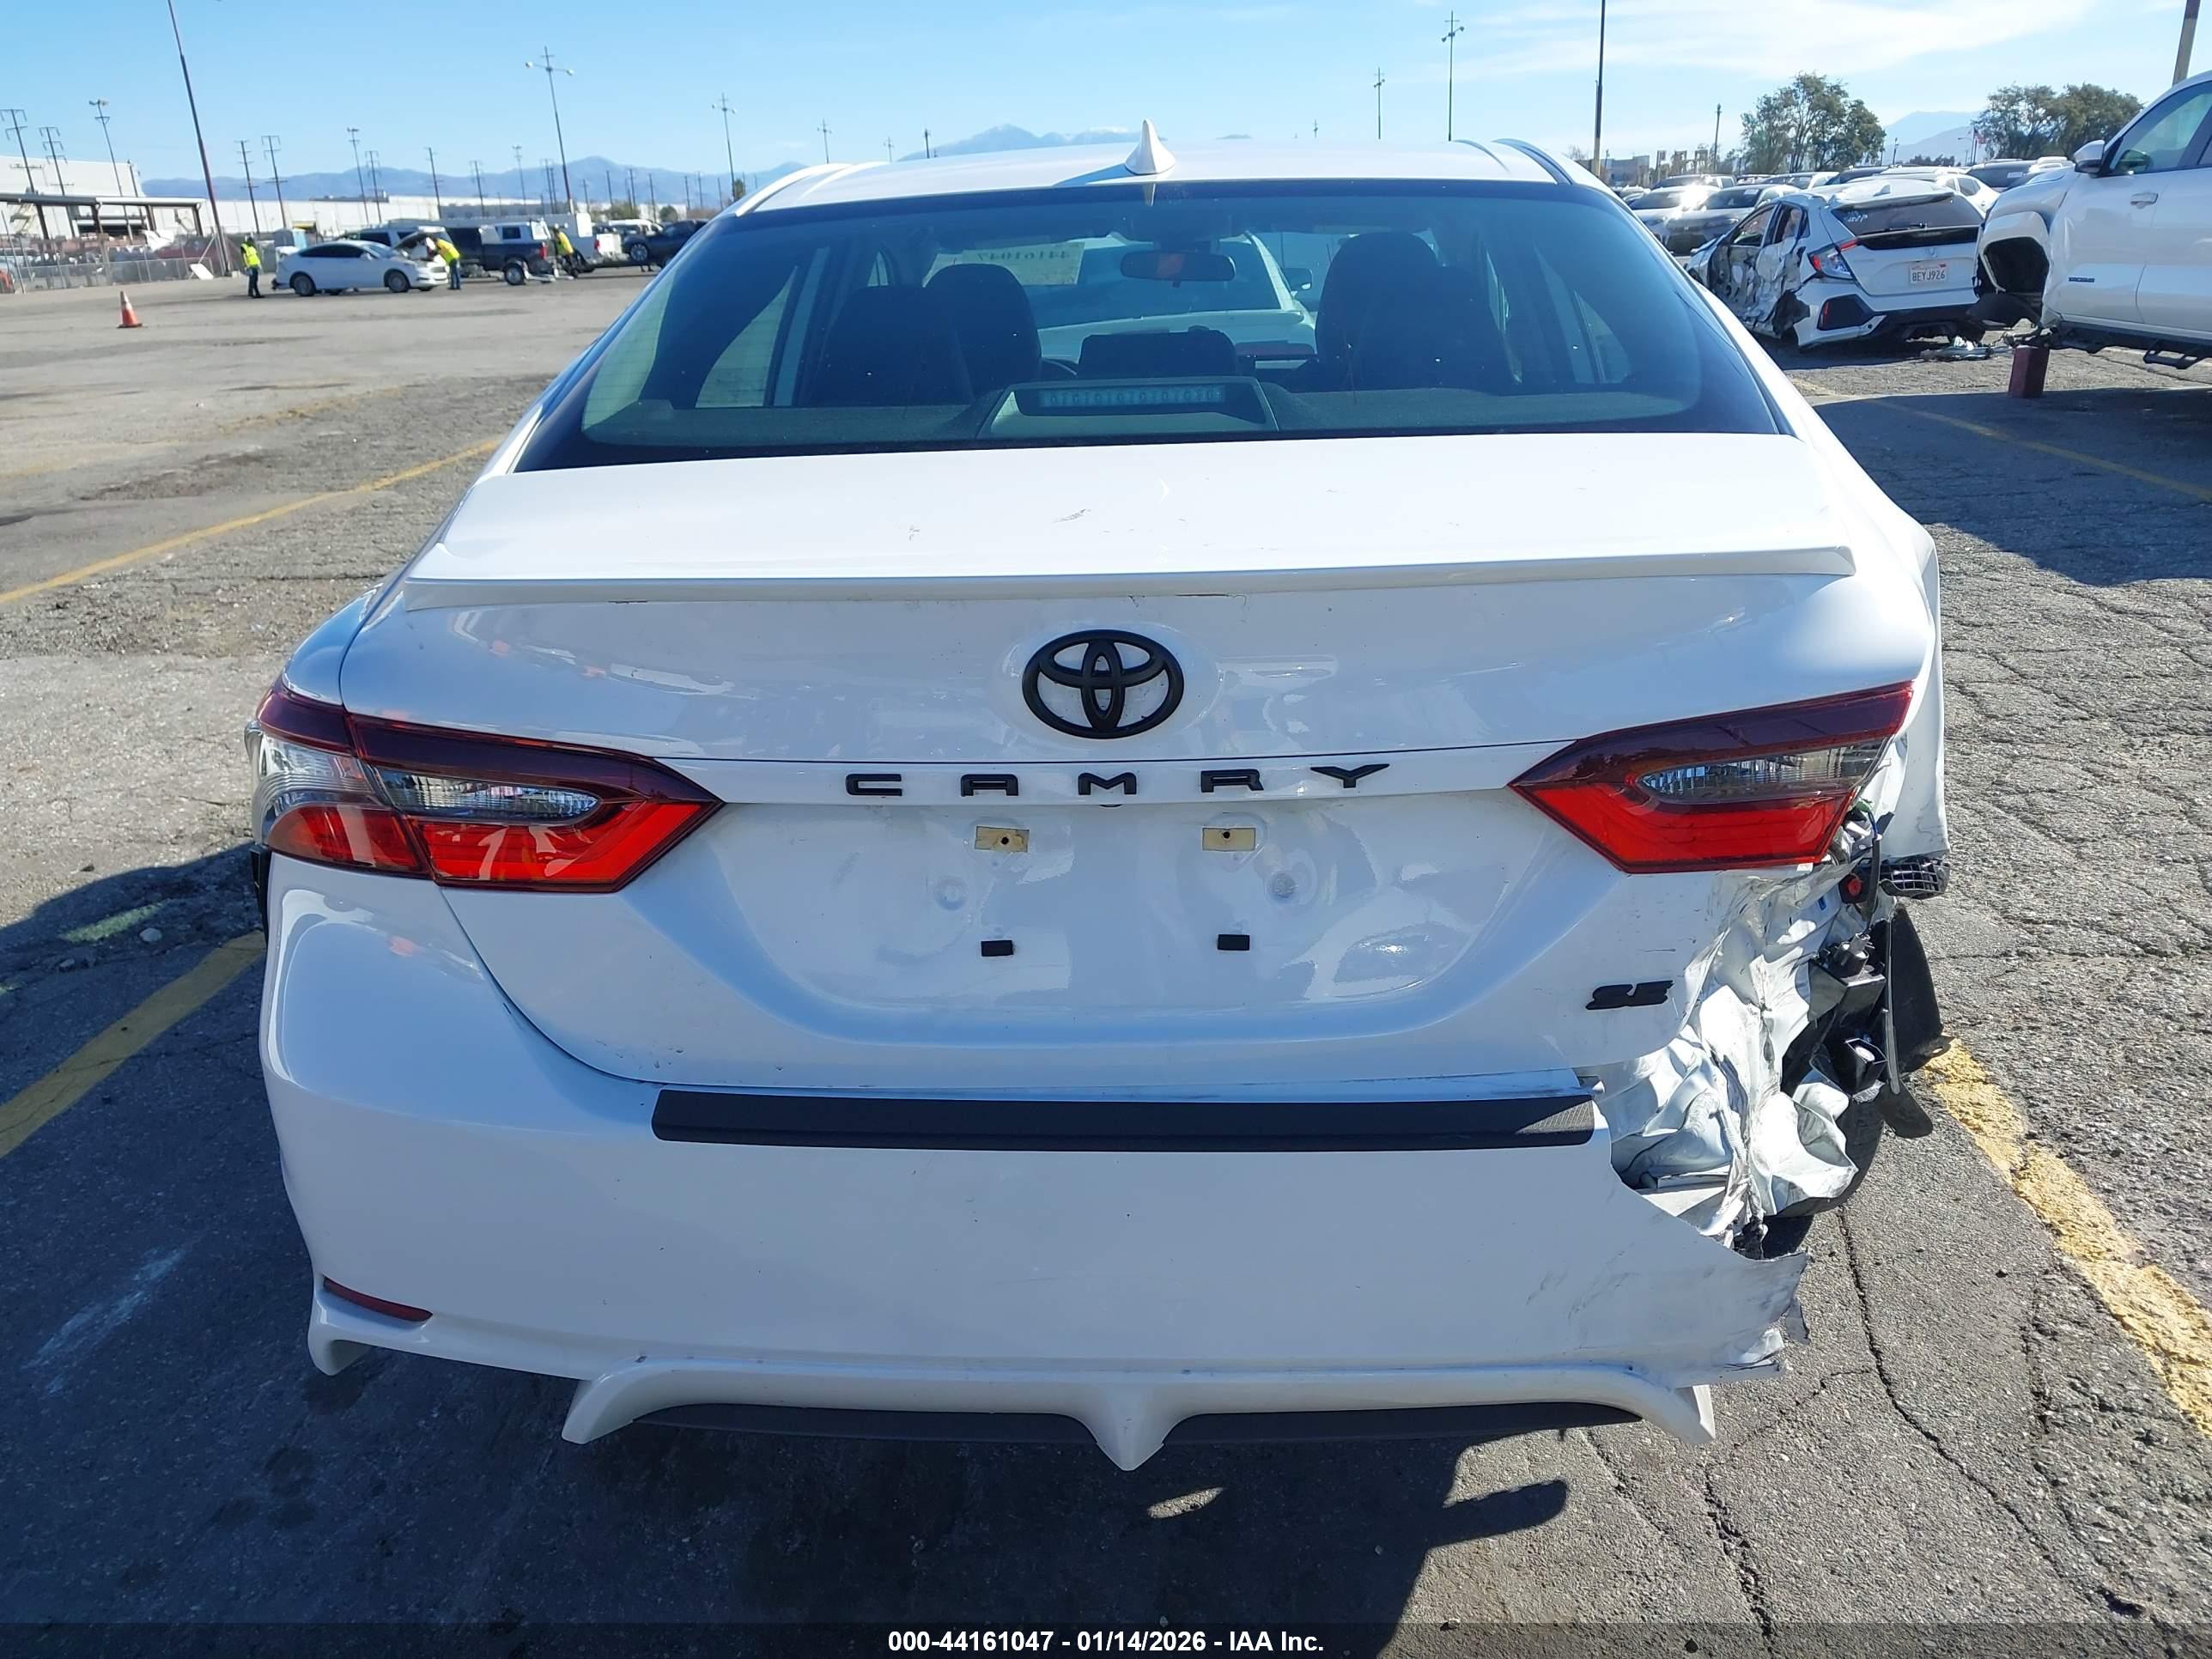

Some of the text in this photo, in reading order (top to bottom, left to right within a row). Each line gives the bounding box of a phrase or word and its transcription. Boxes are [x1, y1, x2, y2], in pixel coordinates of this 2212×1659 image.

[1911, 270, 1946, 282] 8EYJ926
[845, 763, 1390, 797] CAMRY
[1585, 980, 1674, 1010] SE
